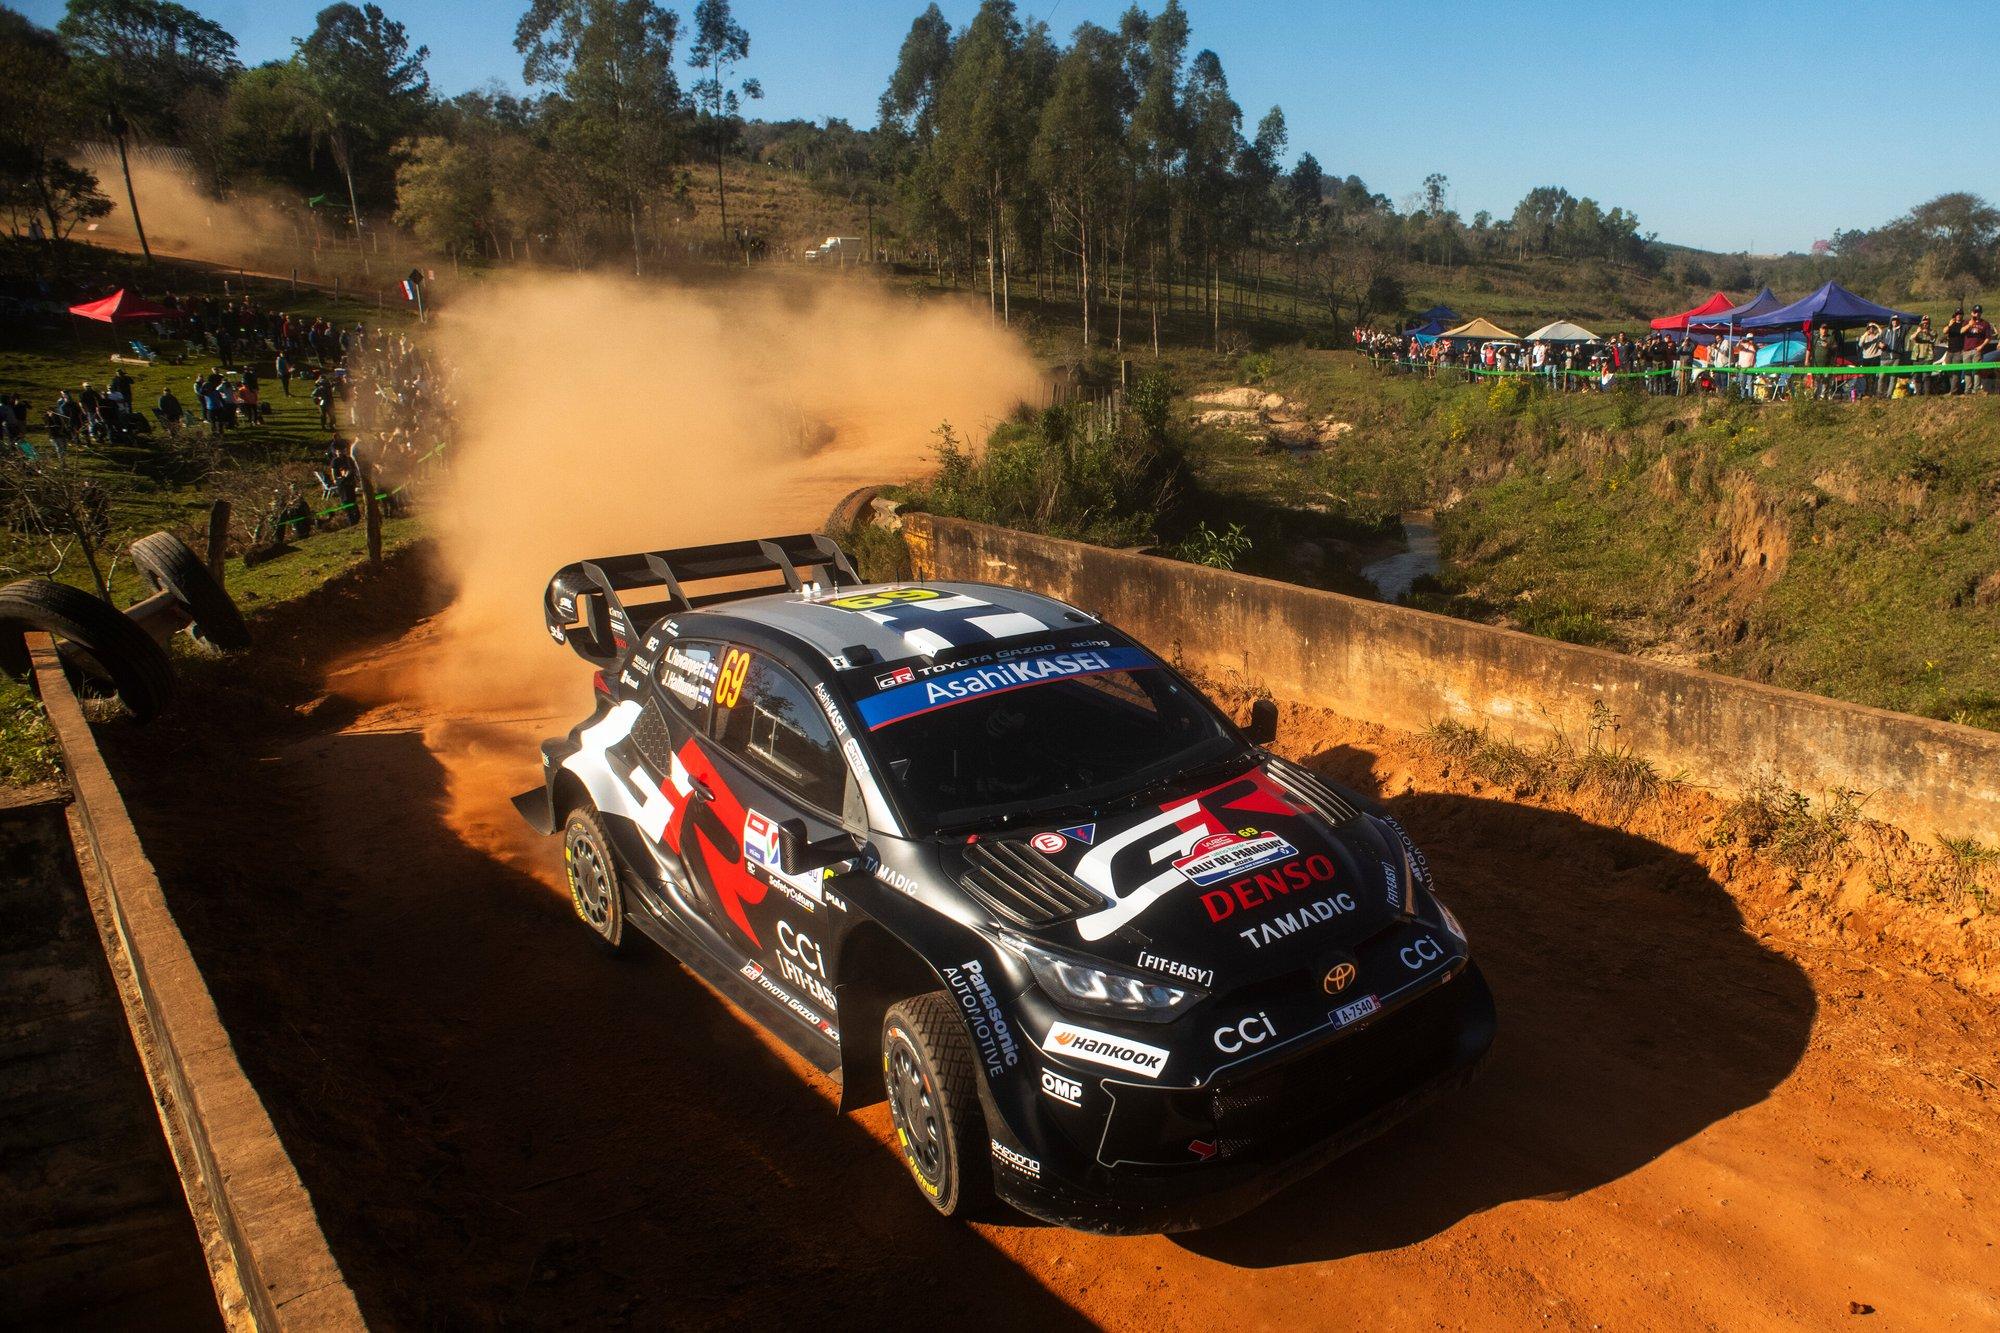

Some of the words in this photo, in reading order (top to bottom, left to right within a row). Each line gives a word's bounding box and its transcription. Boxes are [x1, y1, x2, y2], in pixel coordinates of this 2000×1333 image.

[829, 589, 940, 609] 69
[715, 648, 751, 708] 69
[880, 672, 913, 688] GR
[918, 654, 993, 676] TOYOTA
[996, 644, 1056, 661] GAZOO
[927, 651, 1111, 704] AsahiKASEI
[814, 682, 848, 736] AsahiKASEI
[1040, 836, 1058, 849] E
[1238, 827, 1259, 838] 69
[866, 856, 919, 896] TAMADIC
[1185, 859, 1218, 876] RALLY
[1213, 853, 1236, 867] DEL
[1232, 839, 1285, 860] PARAGUAY
[768, 875, 815, 911] SafetyCulture
[1200, 854, 1336, 923] DENSO
[1239, 892, 1357, 950] TAMADIC
[757, 974, 789, 1004] TOYOTA
[788, 995, 820, 1025] GAZOO
[943, 965, 1004, 1078] AUTOMOTIVE
[961, 959, 1018, 1068] Panasonic
[1340, 999, 1373, 1022] A-7540
[1041, 1073, 1082, 1101] OMP
